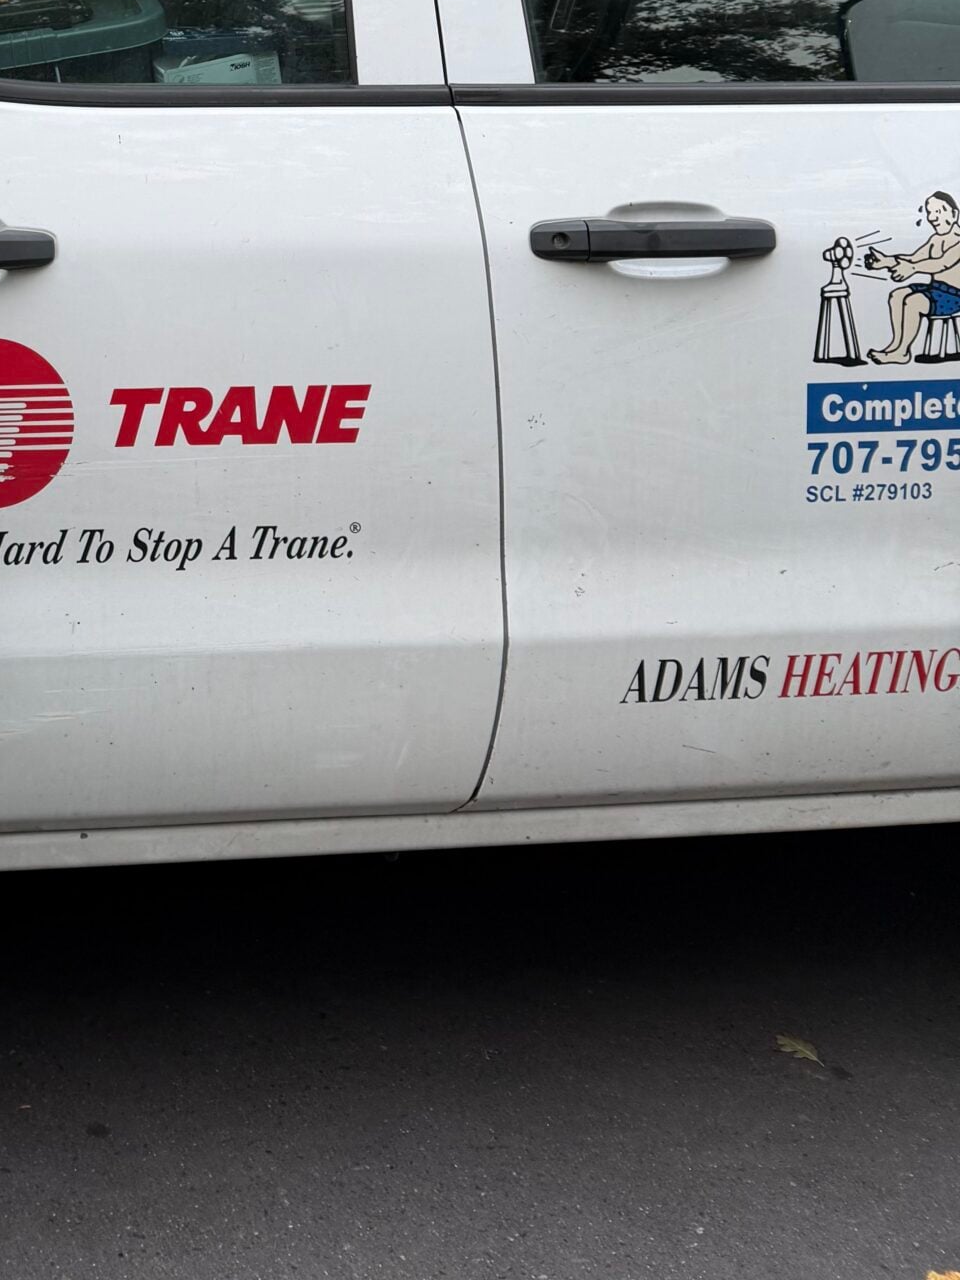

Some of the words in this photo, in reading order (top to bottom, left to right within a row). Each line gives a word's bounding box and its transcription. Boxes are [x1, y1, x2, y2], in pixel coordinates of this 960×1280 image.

[110, 384, 372, 448] TRANE
[822, 391, 960, 427] Complet
[807, 438, 960, 475] 707-795
[806, 485, 846, 503] SCL
[852, 482, 933, 502] #279103
[76, 529, 115, 565] To
[127, 527, 204, 571] Stop
[212, 526, 239, 561] A
[619, 654, 771, 704] ADAMS
[777, 647, 960, 698] HEATING
